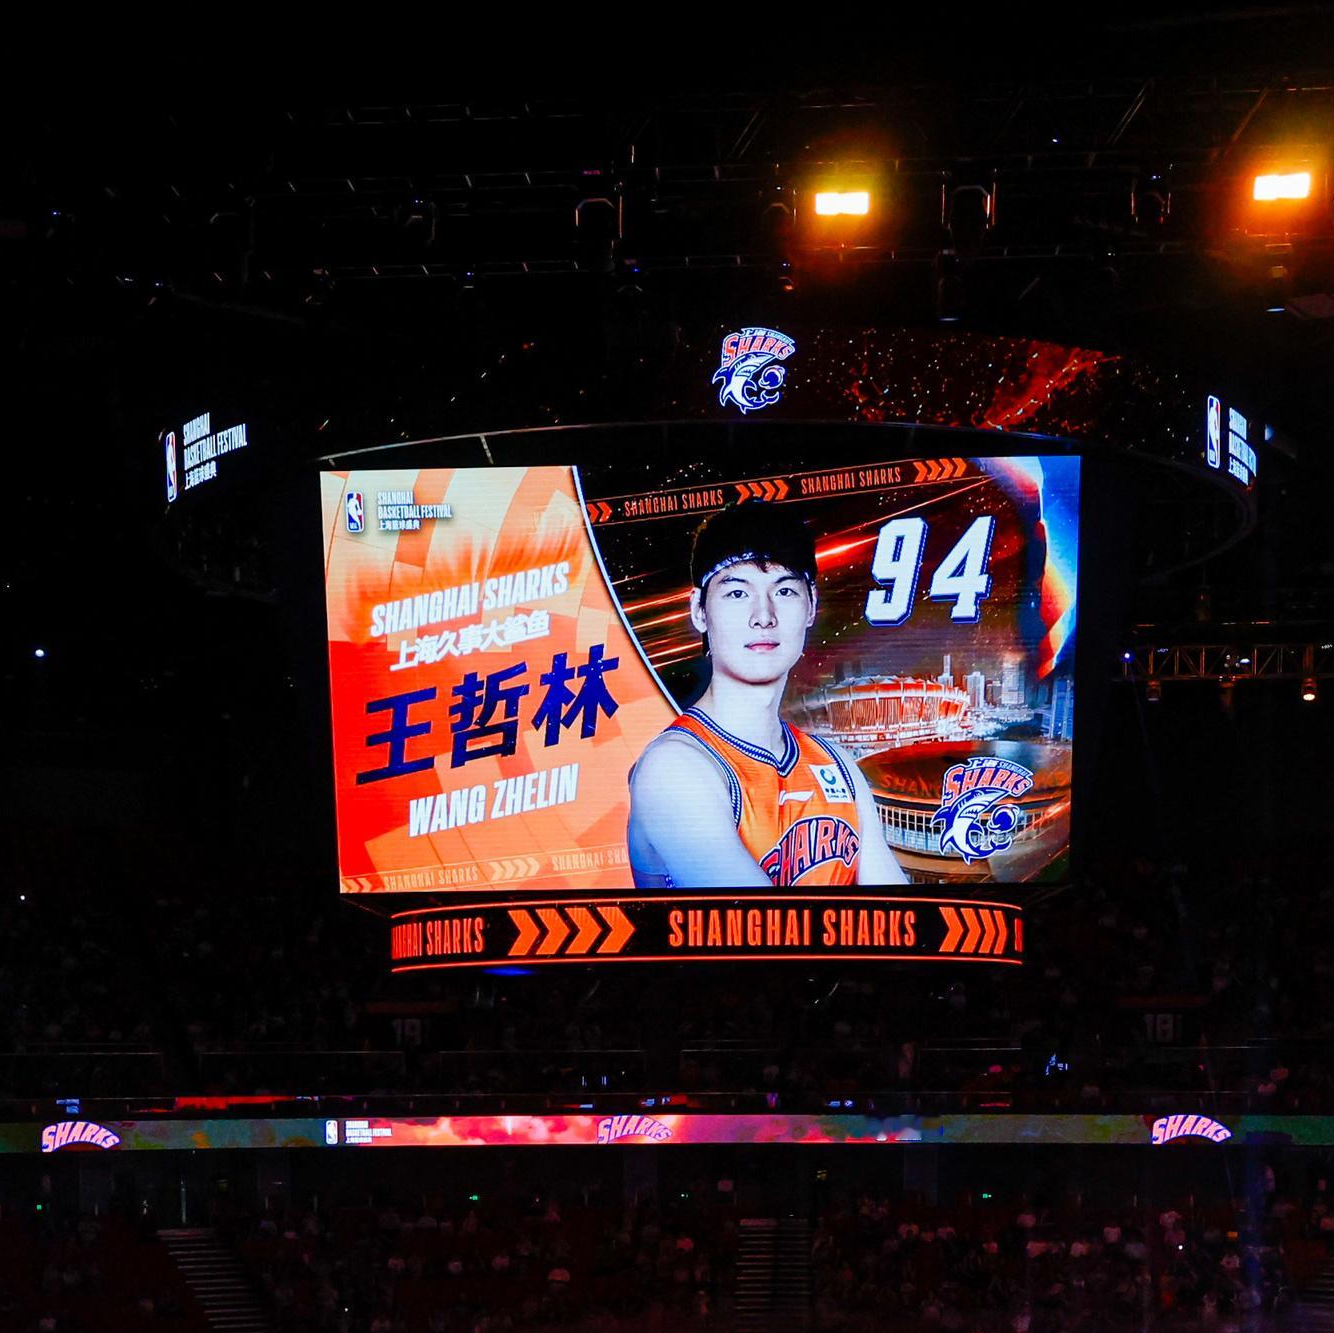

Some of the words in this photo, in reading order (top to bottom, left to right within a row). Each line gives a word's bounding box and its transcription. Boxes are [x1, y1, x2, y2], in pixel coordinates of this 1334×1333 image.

[722, 334, 795, 366] SHARKS
[216, 423, 247, 456] FESTIVAL
[801, 472, 856, 495] SHANGHAI
[859, 465, 902, 486] SHARKS
[377, 491, 414, 505] SHANGHAI
[377, 505, 421, 519] BASKETBALL
[421, 503, 452, 518] FESTIVAL
[624, 495, 679, 517] SHANGHAI
[681, 489, 724, 510] SHARKS
[865, 515, 996, 626] 94
[370, 582, 480, 637] SHANGHAI
[482, 561, 570, 612] SHARKS
[389, 610, 550, 671] 上海久事大鲨鱼
[356, 643, 619, 785] 王哲林
[409, 785, 486, 838] WANG
[491, 763, 579, 819] ZHELIN
[943, 765, 1033, 806] SHARKS
[552, 851, 604, 871] SHANGHAI
[607, 848, 629, 867] SHA
[383, 871, 435, 891] SHANGHAI
[438, 866, 479, 885] SHARKS
[426, 917, 484, 956] SHARKS
[669, 909, 811, 947] SHANGHAI
[823, 909, 916, 947] SHARKS
[42, 1121, 120, 1153] SHARKS
[598, 1115, 673, 1144] SHARKS
[1152, 1115, 1232, 1144] SHARKS
